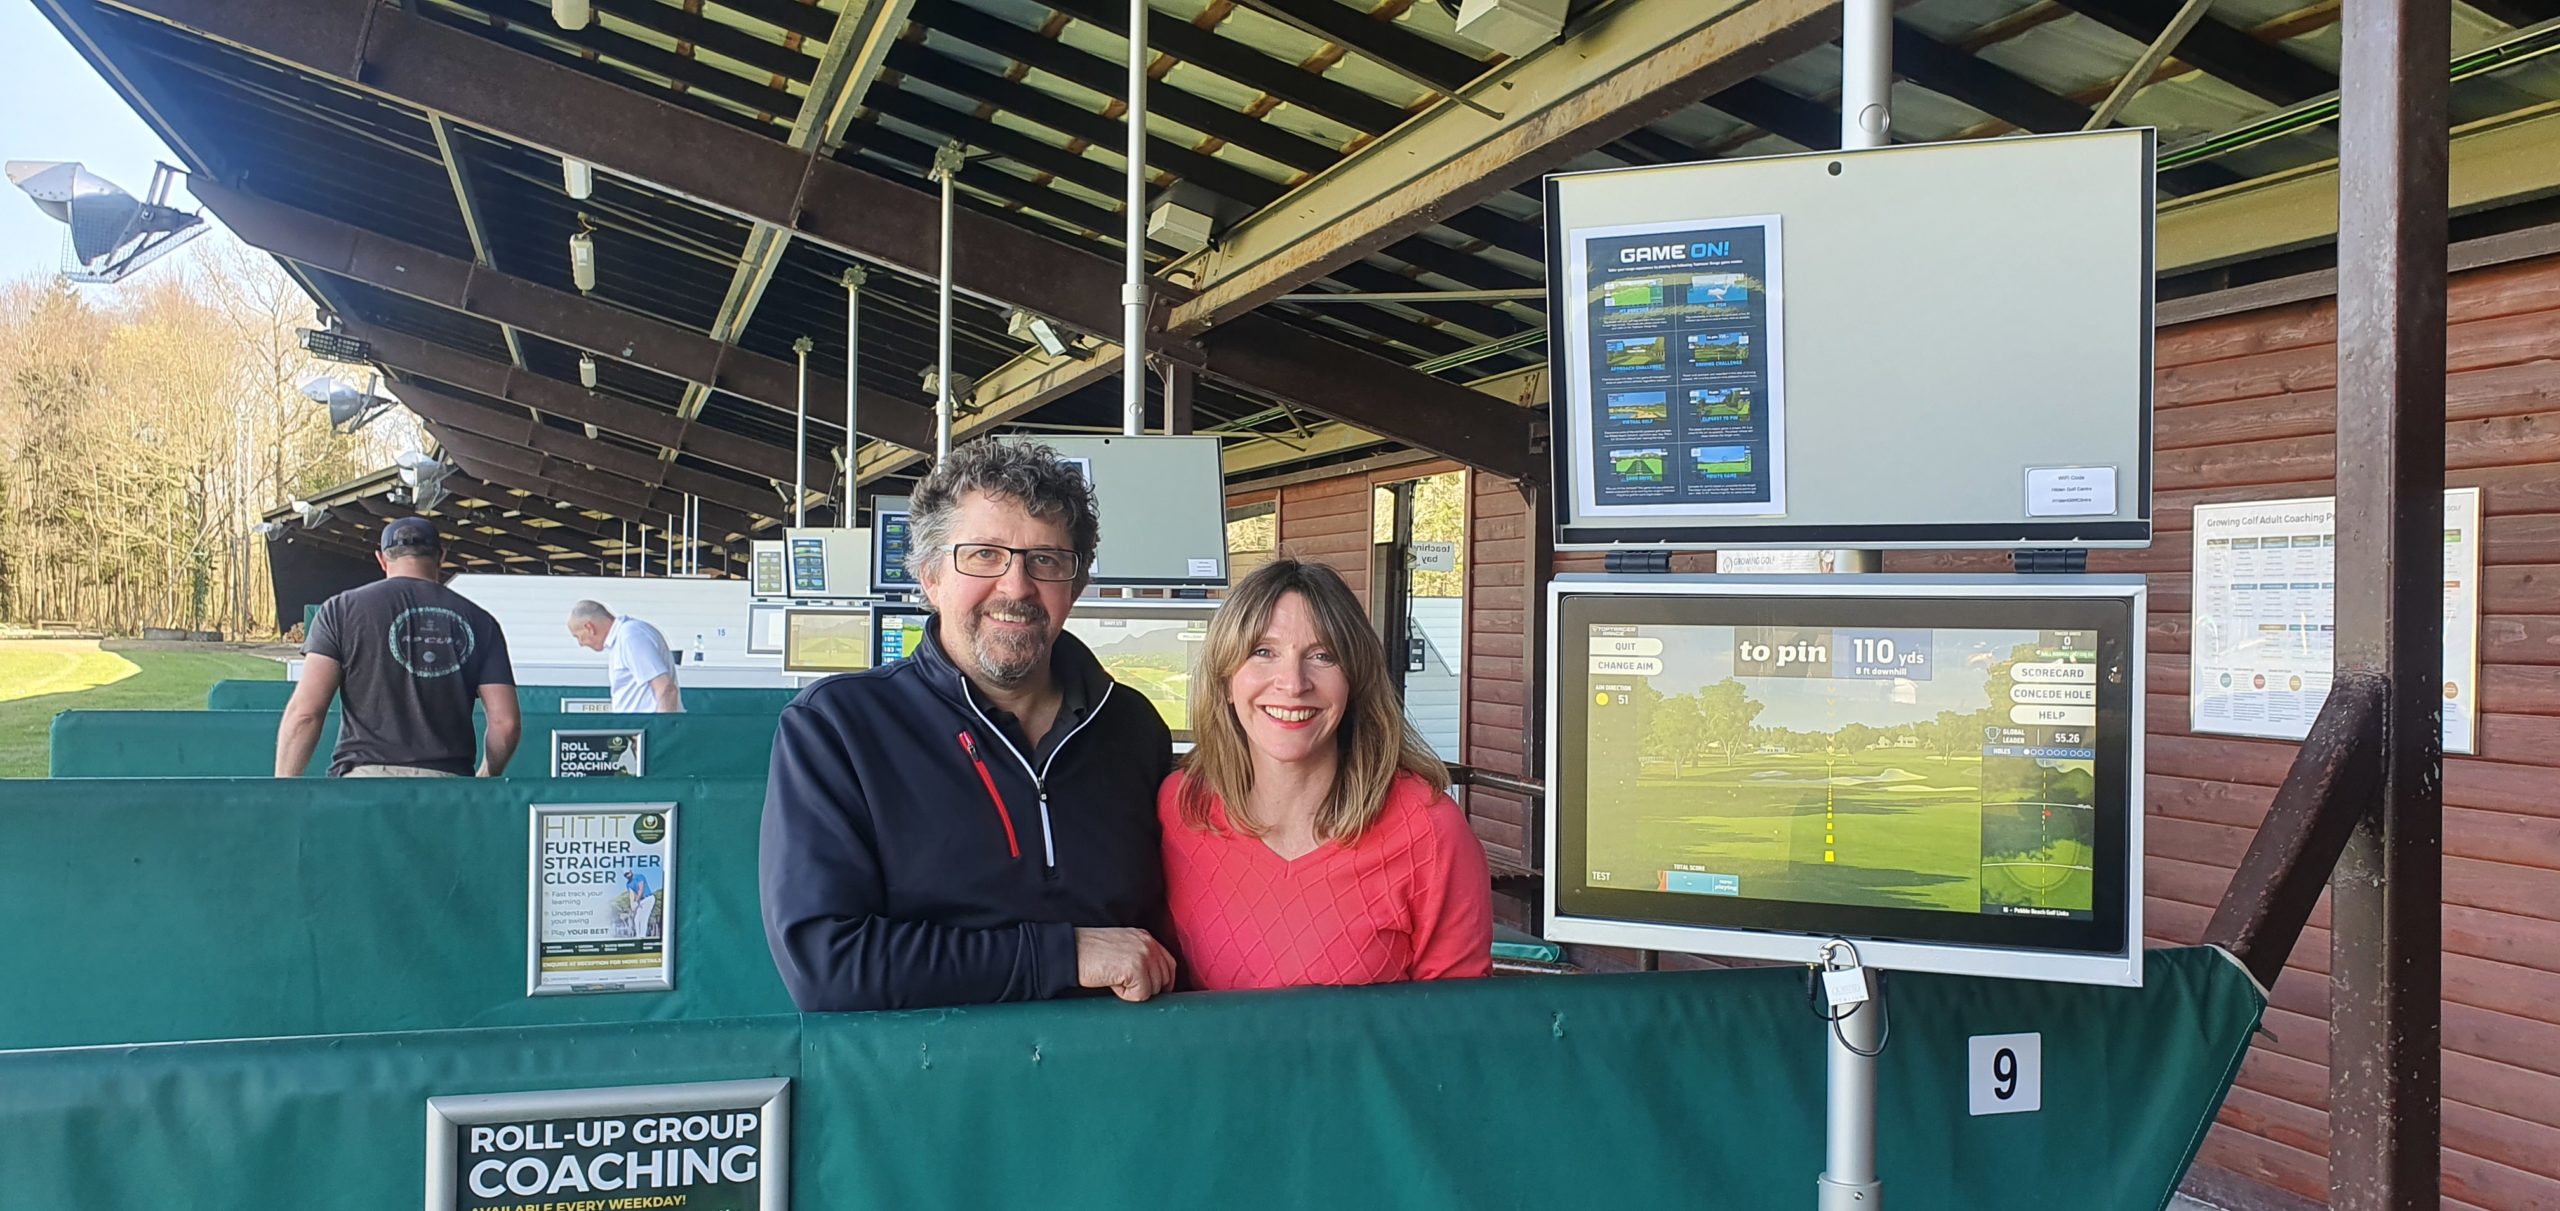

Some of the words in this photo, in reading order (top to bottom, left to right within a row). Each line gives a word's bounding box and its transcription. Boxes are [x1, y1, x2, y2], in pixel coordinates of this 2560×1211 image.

[1620, 244, 1686, 263] GAME
[1690, 241, 1729, 259] ON!
[2207, 516, 2240, 528] Growing
[2242, 516, 2259, 525] Golf
[2260, 515, 2282, 524] Adult
[2284, 513, 2324, 524] Coaching
[1734, 557, 1760, 566] GROWING
[1615, 643, 1636, 651] QUIT
[1739, 640, 1770, 662] to
[1776, 641, 1827, 666] pin
[1854, 639, 1894, 664] 110
[1898, 651, 1924, 666] yds
[1598, 662, 1634, 670] CHANGE
[1637, 662, 1653, 670] AIM
[1863, 667, 1870, 675] ft
[1872, 667, 1907, 675] downhill
[2021, 668, 2084, 678] SCORECARD
[1618, 694, 1628, 704] 51
[2014, 689, 2062, 699] CONCEDE
[2064, 690, 2092, 699] HOLE
[2038, 711, 2065, 720] HELP
[2055, 734, 2080, 743] 55.26
[561, 742, 590, 751] ROLL
[561, 752, 577, 761] UP
[578, 752, 608, 760] GOLF
[561, 761, 620, 770] COACHING
[544, 816, 595, 839] HIT
[601, 816, 626, 838] IT
[544, 841, 631, 854] FURTHER
[544, 855, 660, 870] STRAIGHTER
[544, 870, 616, 884] CLOSER
[1592, 871, 1610, 881] TEST
[1994, 1048, 2018, 1100] 9
[470, 1120, 627, 1154] ROLL-UP
[633, 1114, 758, 1144] GROUP
[469, 1145, 757, 1198] COACHING
[556, 1200, 606, 1211] EVERY
[609, 1195, 687, 1210] WEEKDAY!
